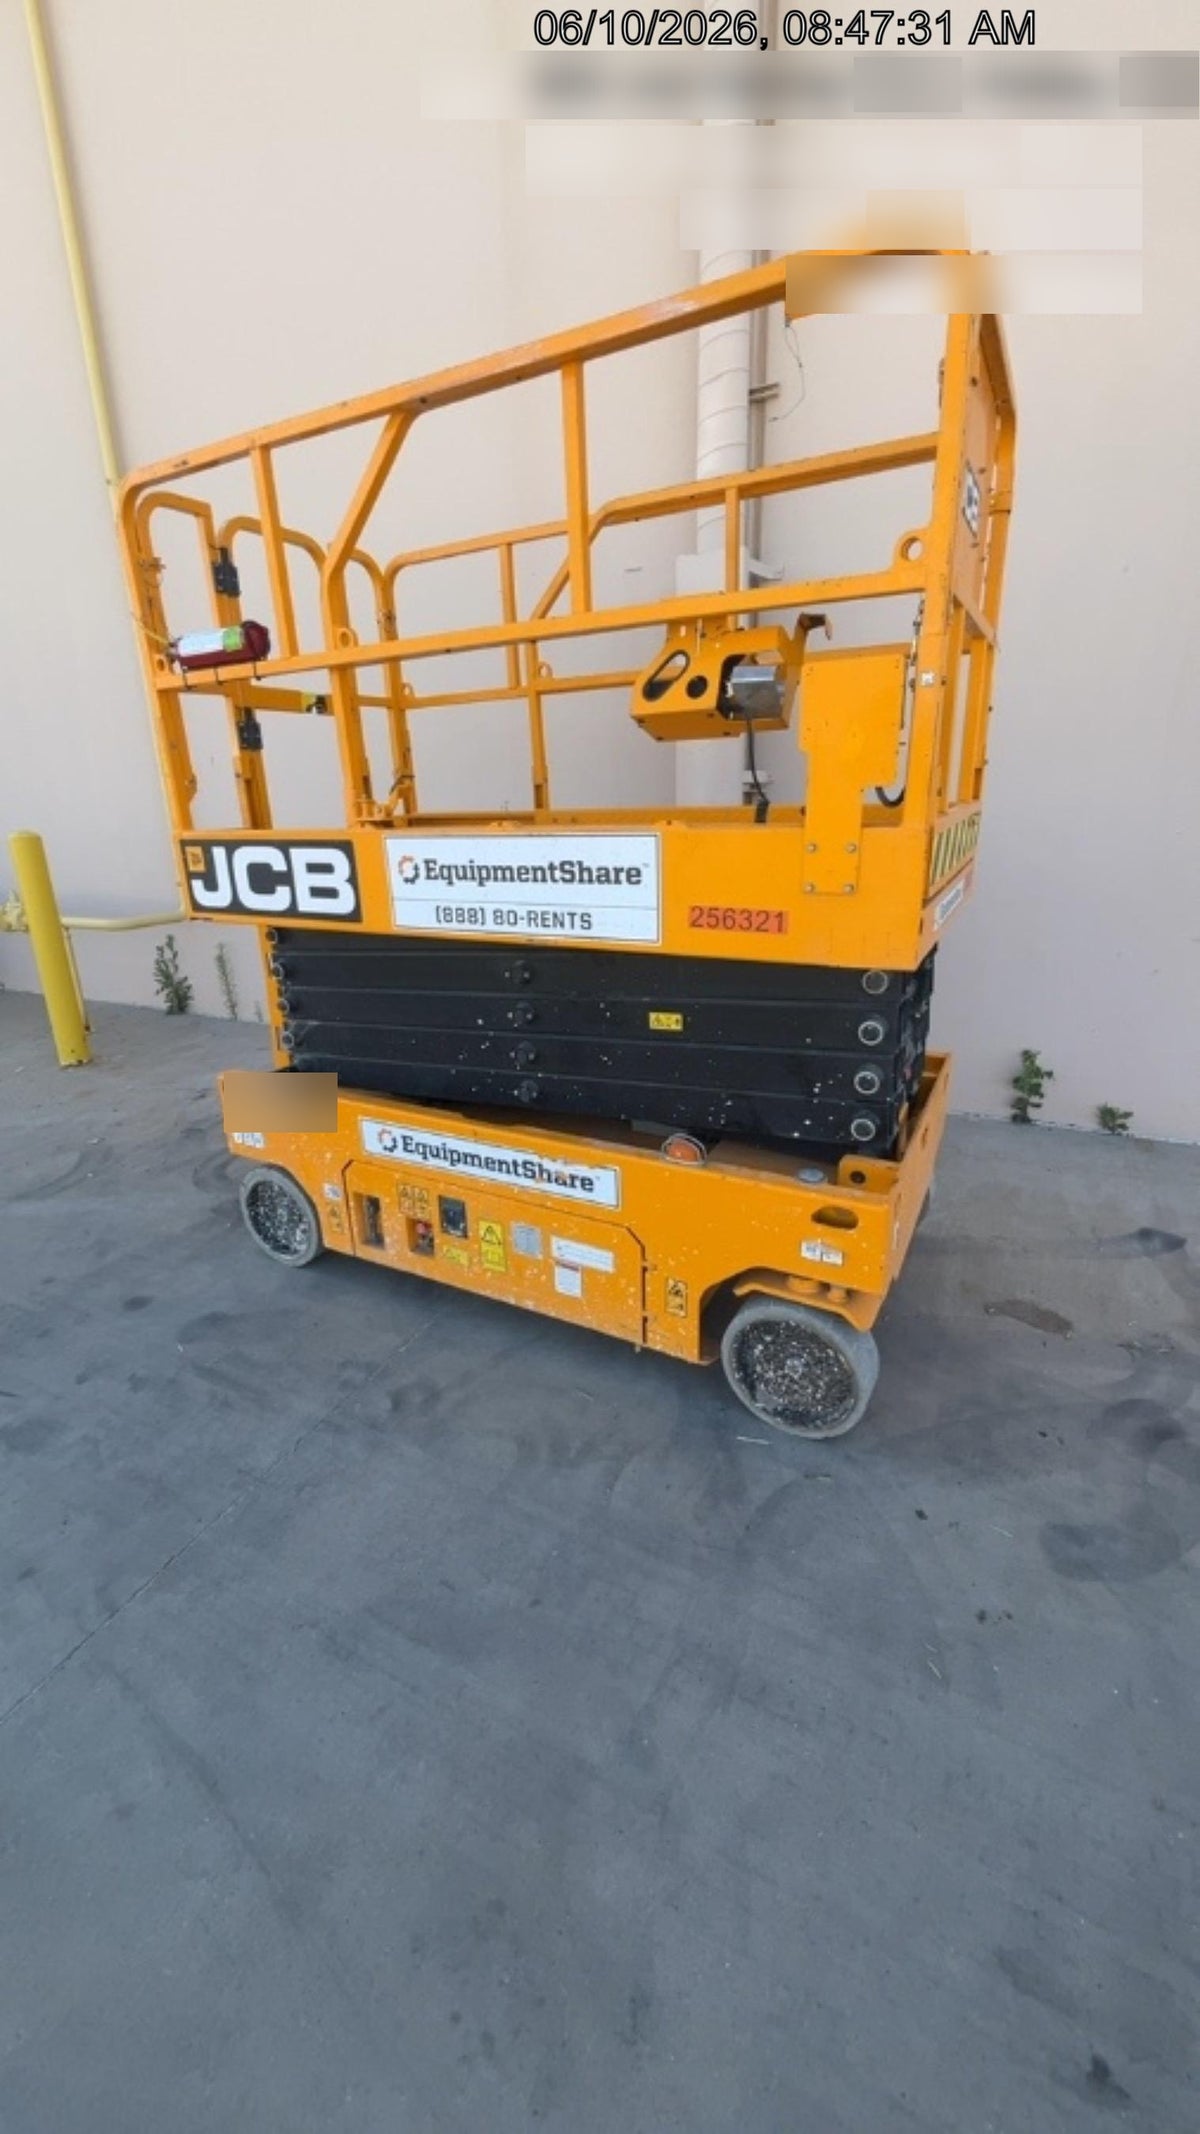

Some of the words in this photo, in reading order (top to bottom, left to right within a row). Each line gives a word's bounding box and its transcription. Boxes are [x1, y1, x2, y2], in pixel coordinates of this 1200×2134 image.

[190, 845, 357, 915] JCB
[423, 859, 643, 887] EquipmentShare
[435, 905, 486, 926] (888)
[492, 909, 592, 930] 80-RENTS
[690, 905, 784, 933] 256321
[401, 1134, 595, 1193] EquipmentShare
